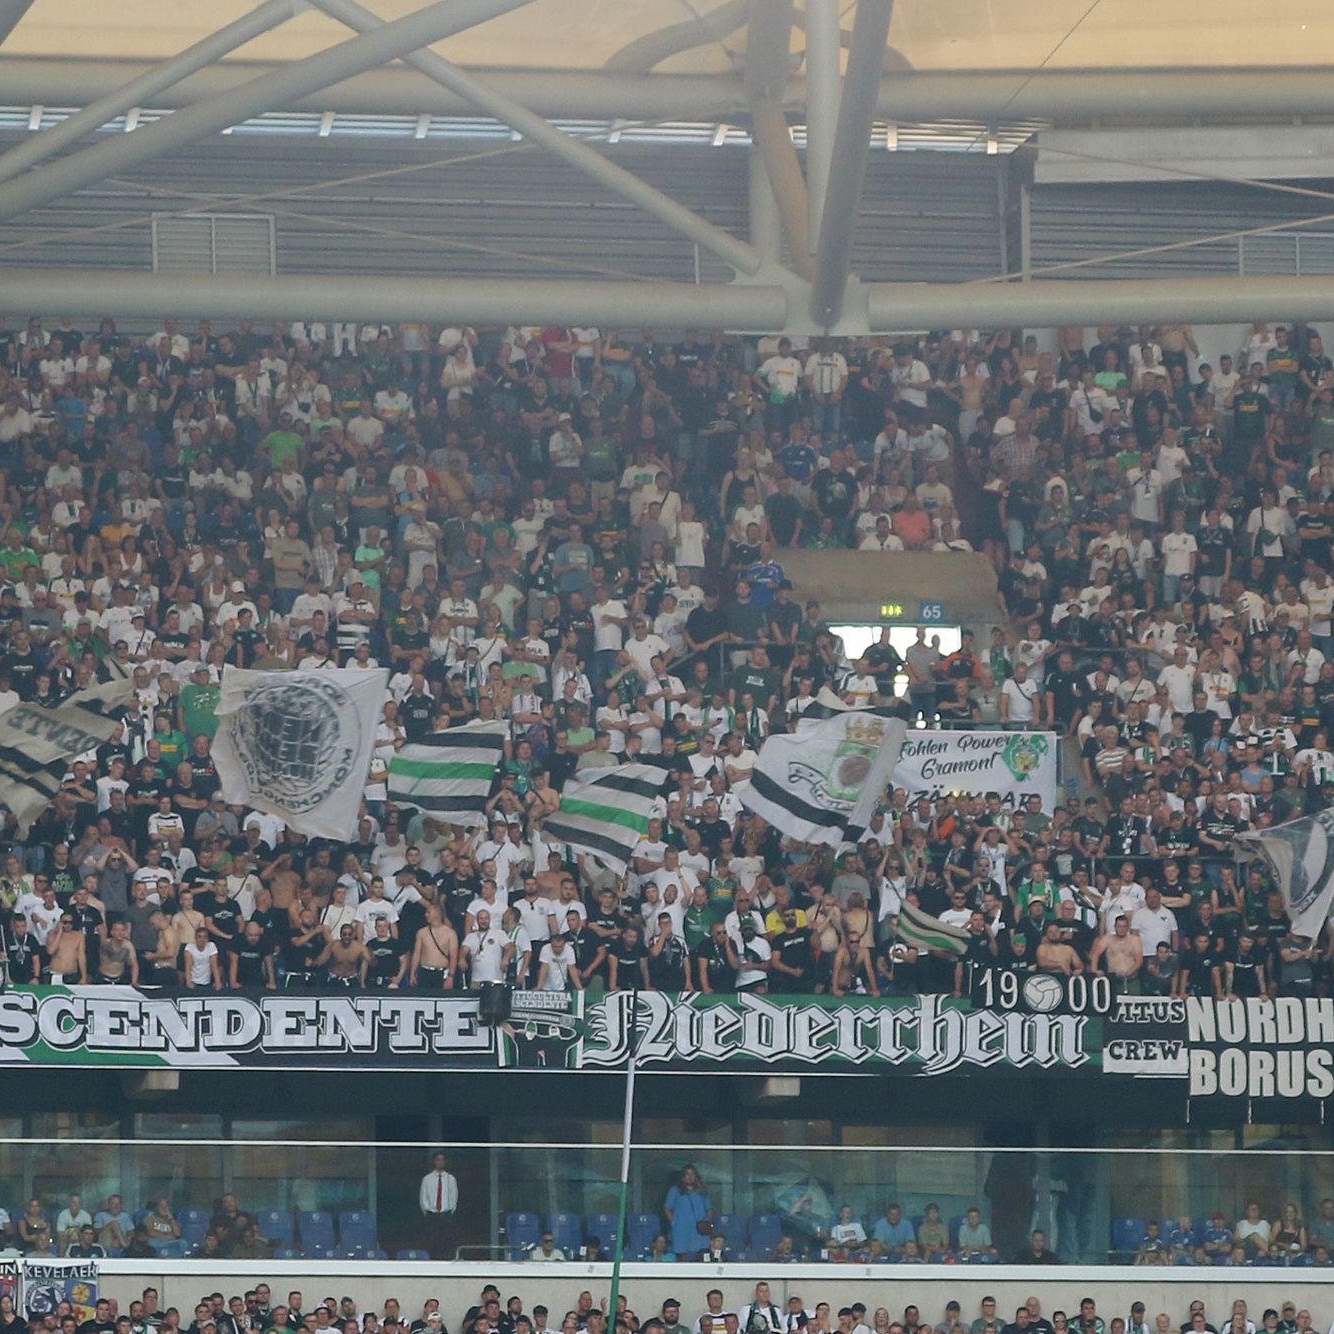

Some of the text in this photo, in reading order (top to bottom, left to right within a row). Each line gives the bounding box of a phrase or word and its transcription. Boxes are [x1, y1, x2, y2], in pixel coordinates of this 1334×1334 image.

[923, 605, 942, 619] 65
[900, 739, 948, 760] Fohlen
[582, 990, 1091, 1076] Niederrhein
[1108, 1040, 1185, 1062] CREW
[24, 1265, 97, 1278] KEVELAER
